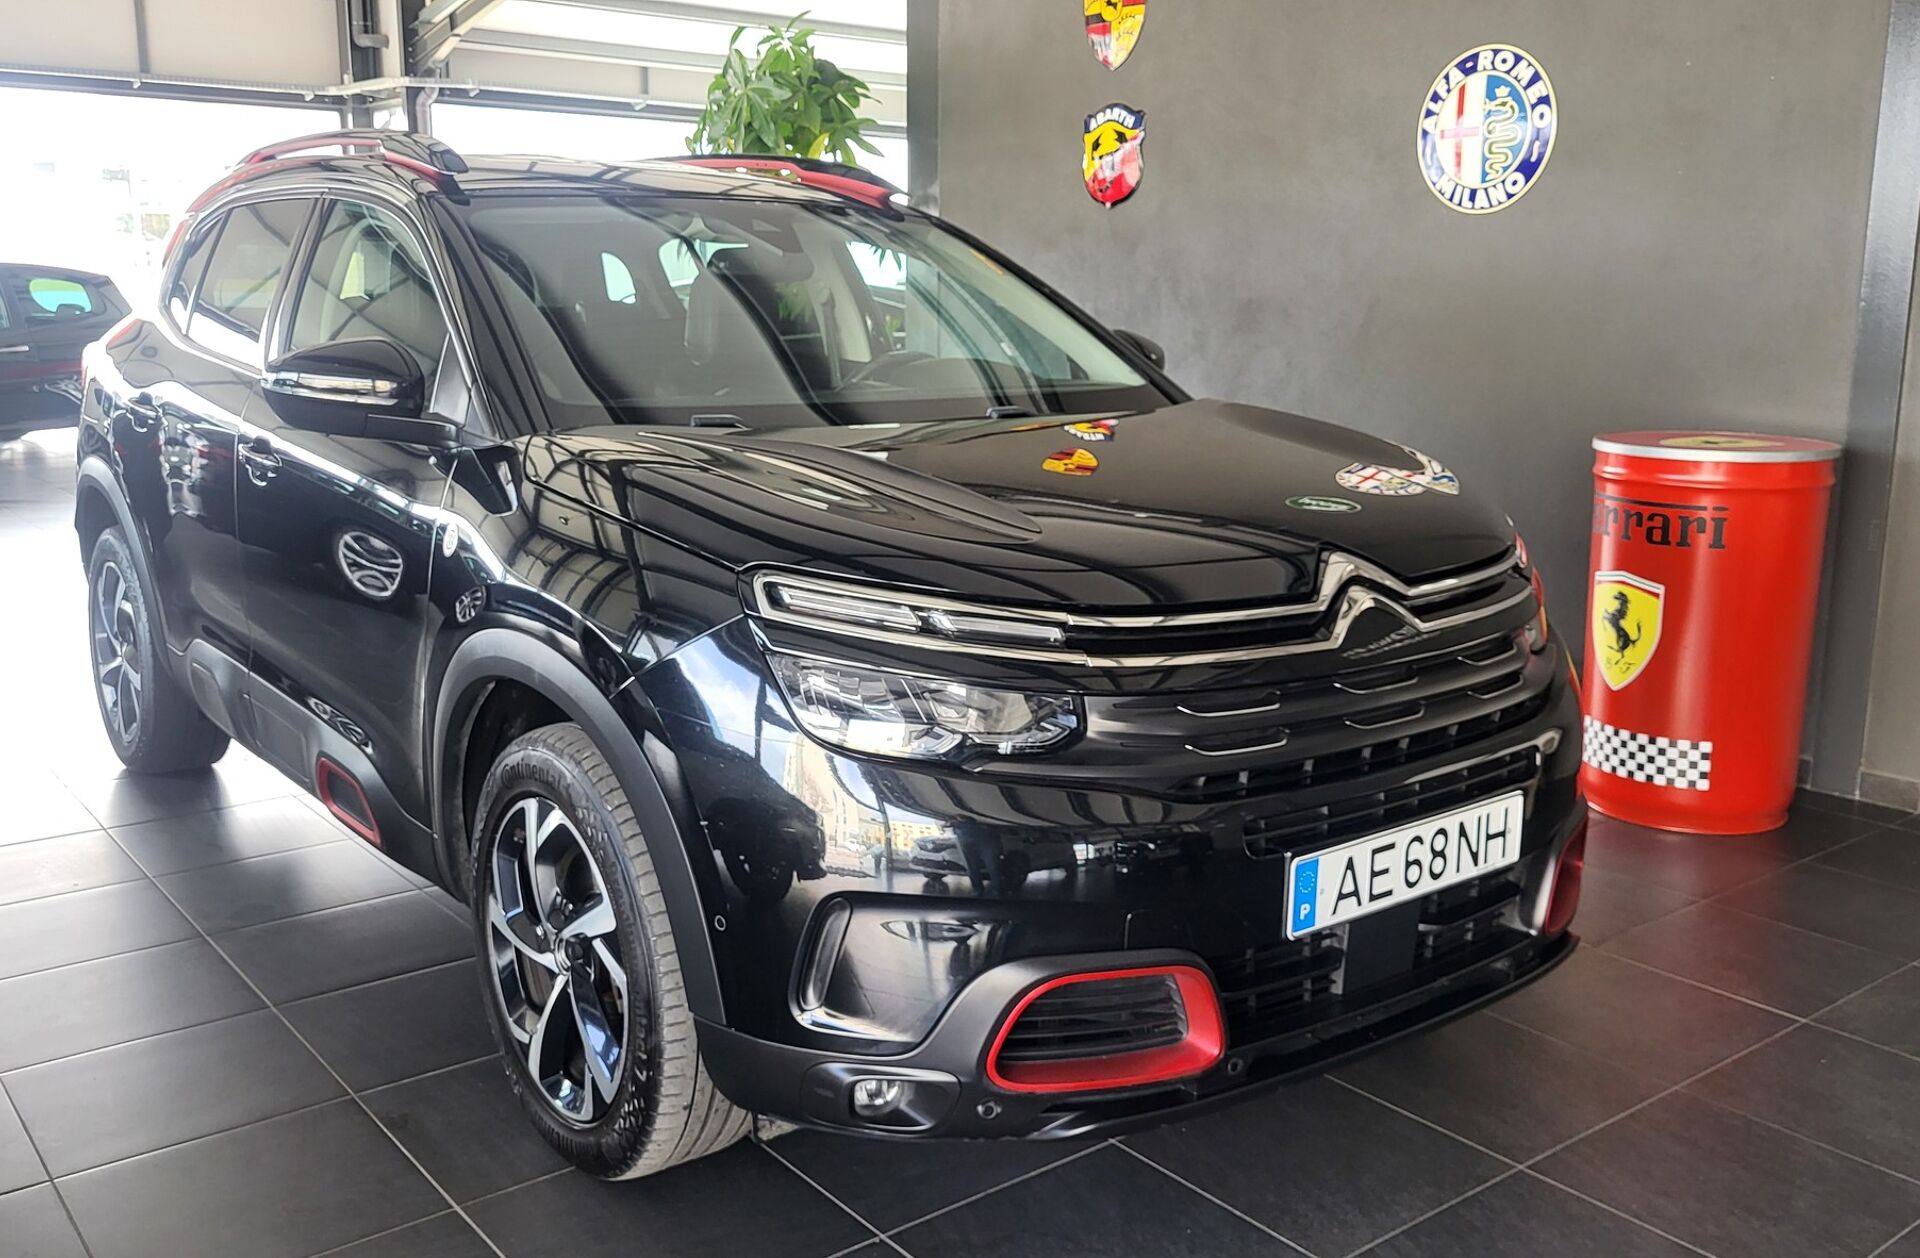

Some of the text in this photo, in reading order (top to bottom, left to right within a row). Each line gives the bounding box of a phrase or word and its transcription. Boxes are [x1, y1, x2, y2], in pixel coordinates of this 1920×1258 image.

[1089, 106, 1136, 132] ABARTH
[1434, 171, 1526, 209] MILANO
[1300, 903, 1311, 921] P
